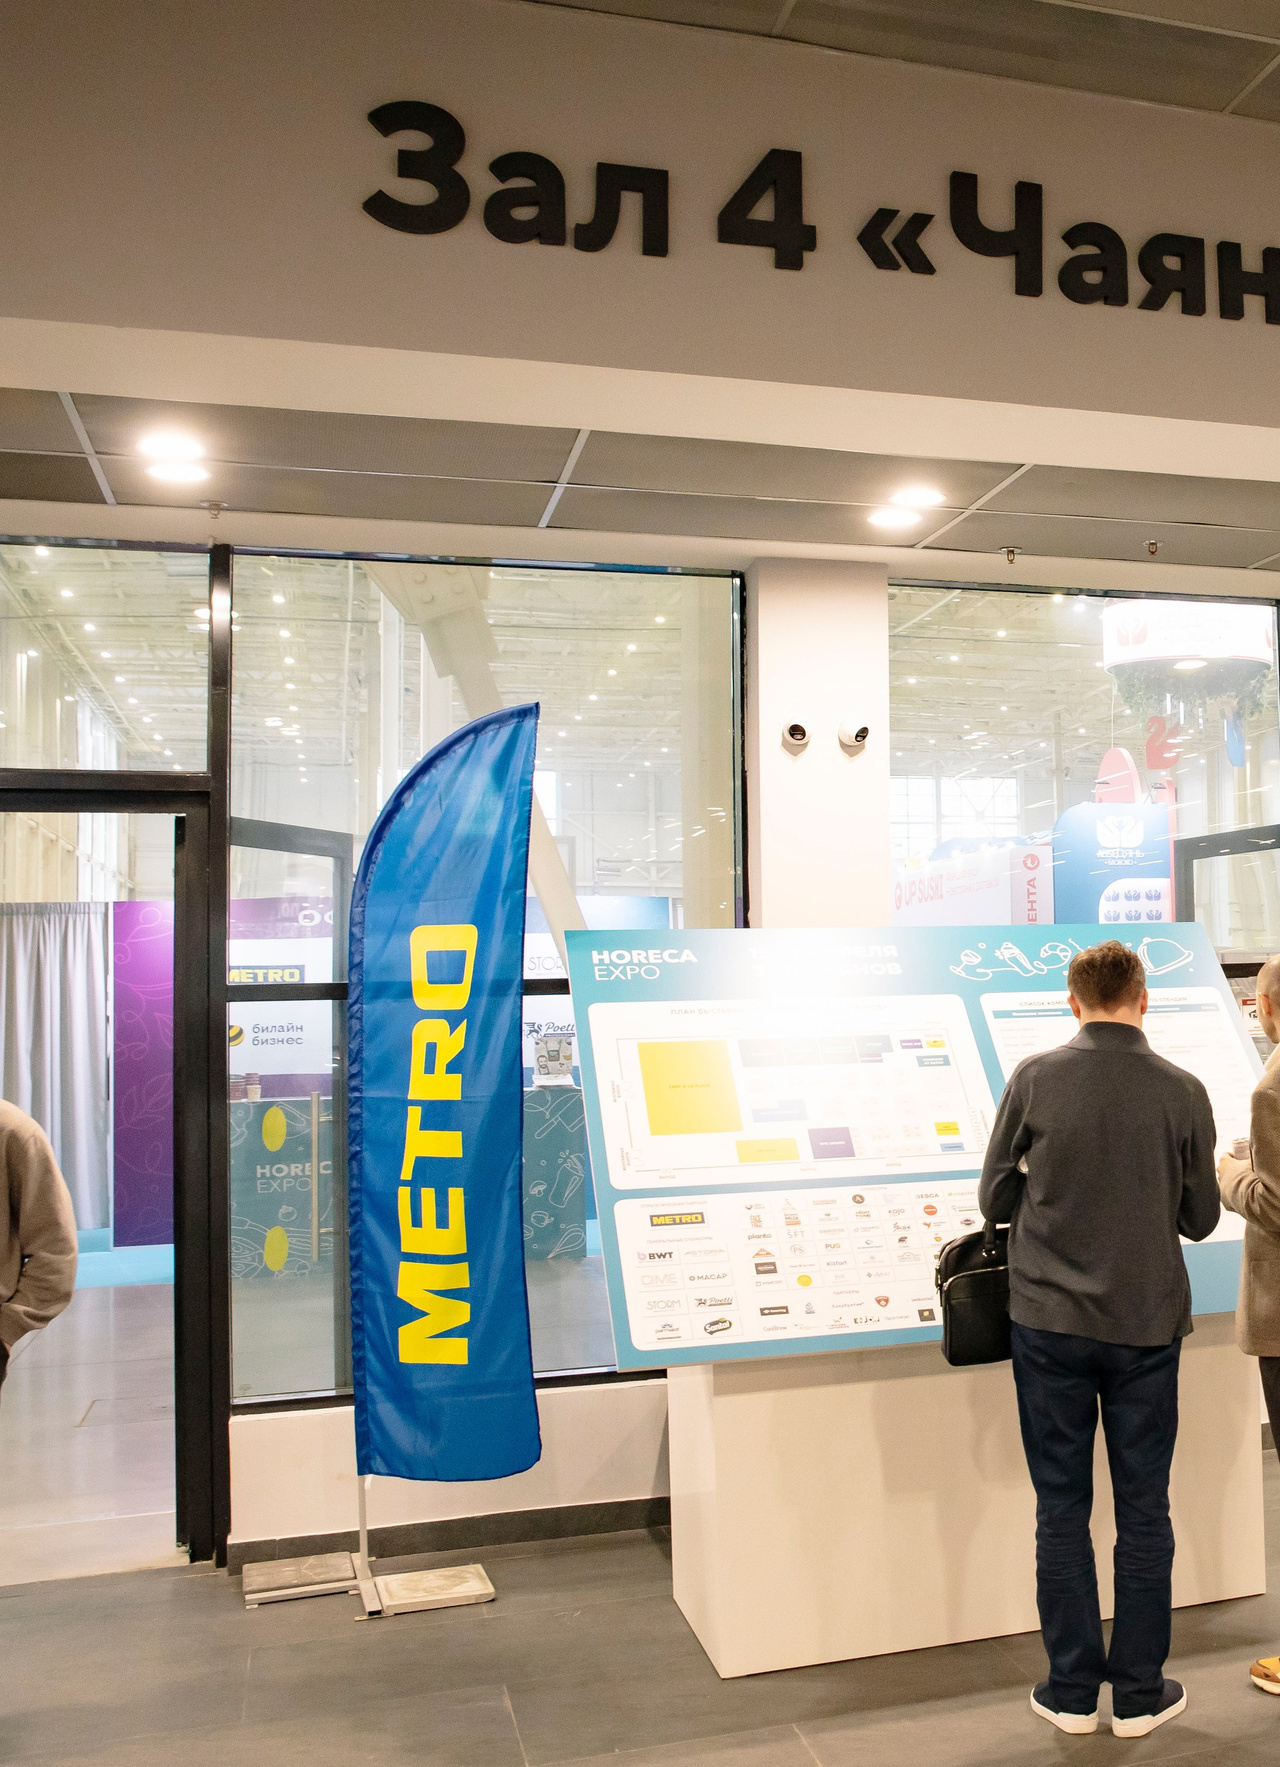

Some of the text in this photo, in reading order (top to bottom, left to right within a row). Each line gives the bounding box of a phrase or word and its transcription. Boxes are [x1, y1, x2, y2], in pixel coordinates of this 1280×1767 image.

[361, 99, 669, 258] Зал
[716, 148, 817, 272] 4
[1027, 877, 1038, 926] ЕНТА
[591, 949, 698, 965] HORECA
[229, 968, 301, 983] METRO
[593, 965, 660, 981] EXPO
[252, 1022, 304, 1034] билайн
[252, 1035, 304, 1047] бизнес
[397, 924, 478, 1366] METRO
[257, 1177, 312, 1194] EXPO
[652, 1213, 703, 1225] METRO
[648, 1252, 674, 1261] BWT
[697, 1273, 728, 1281] MACAP
[647, 1299, 681, 1311] STORM
